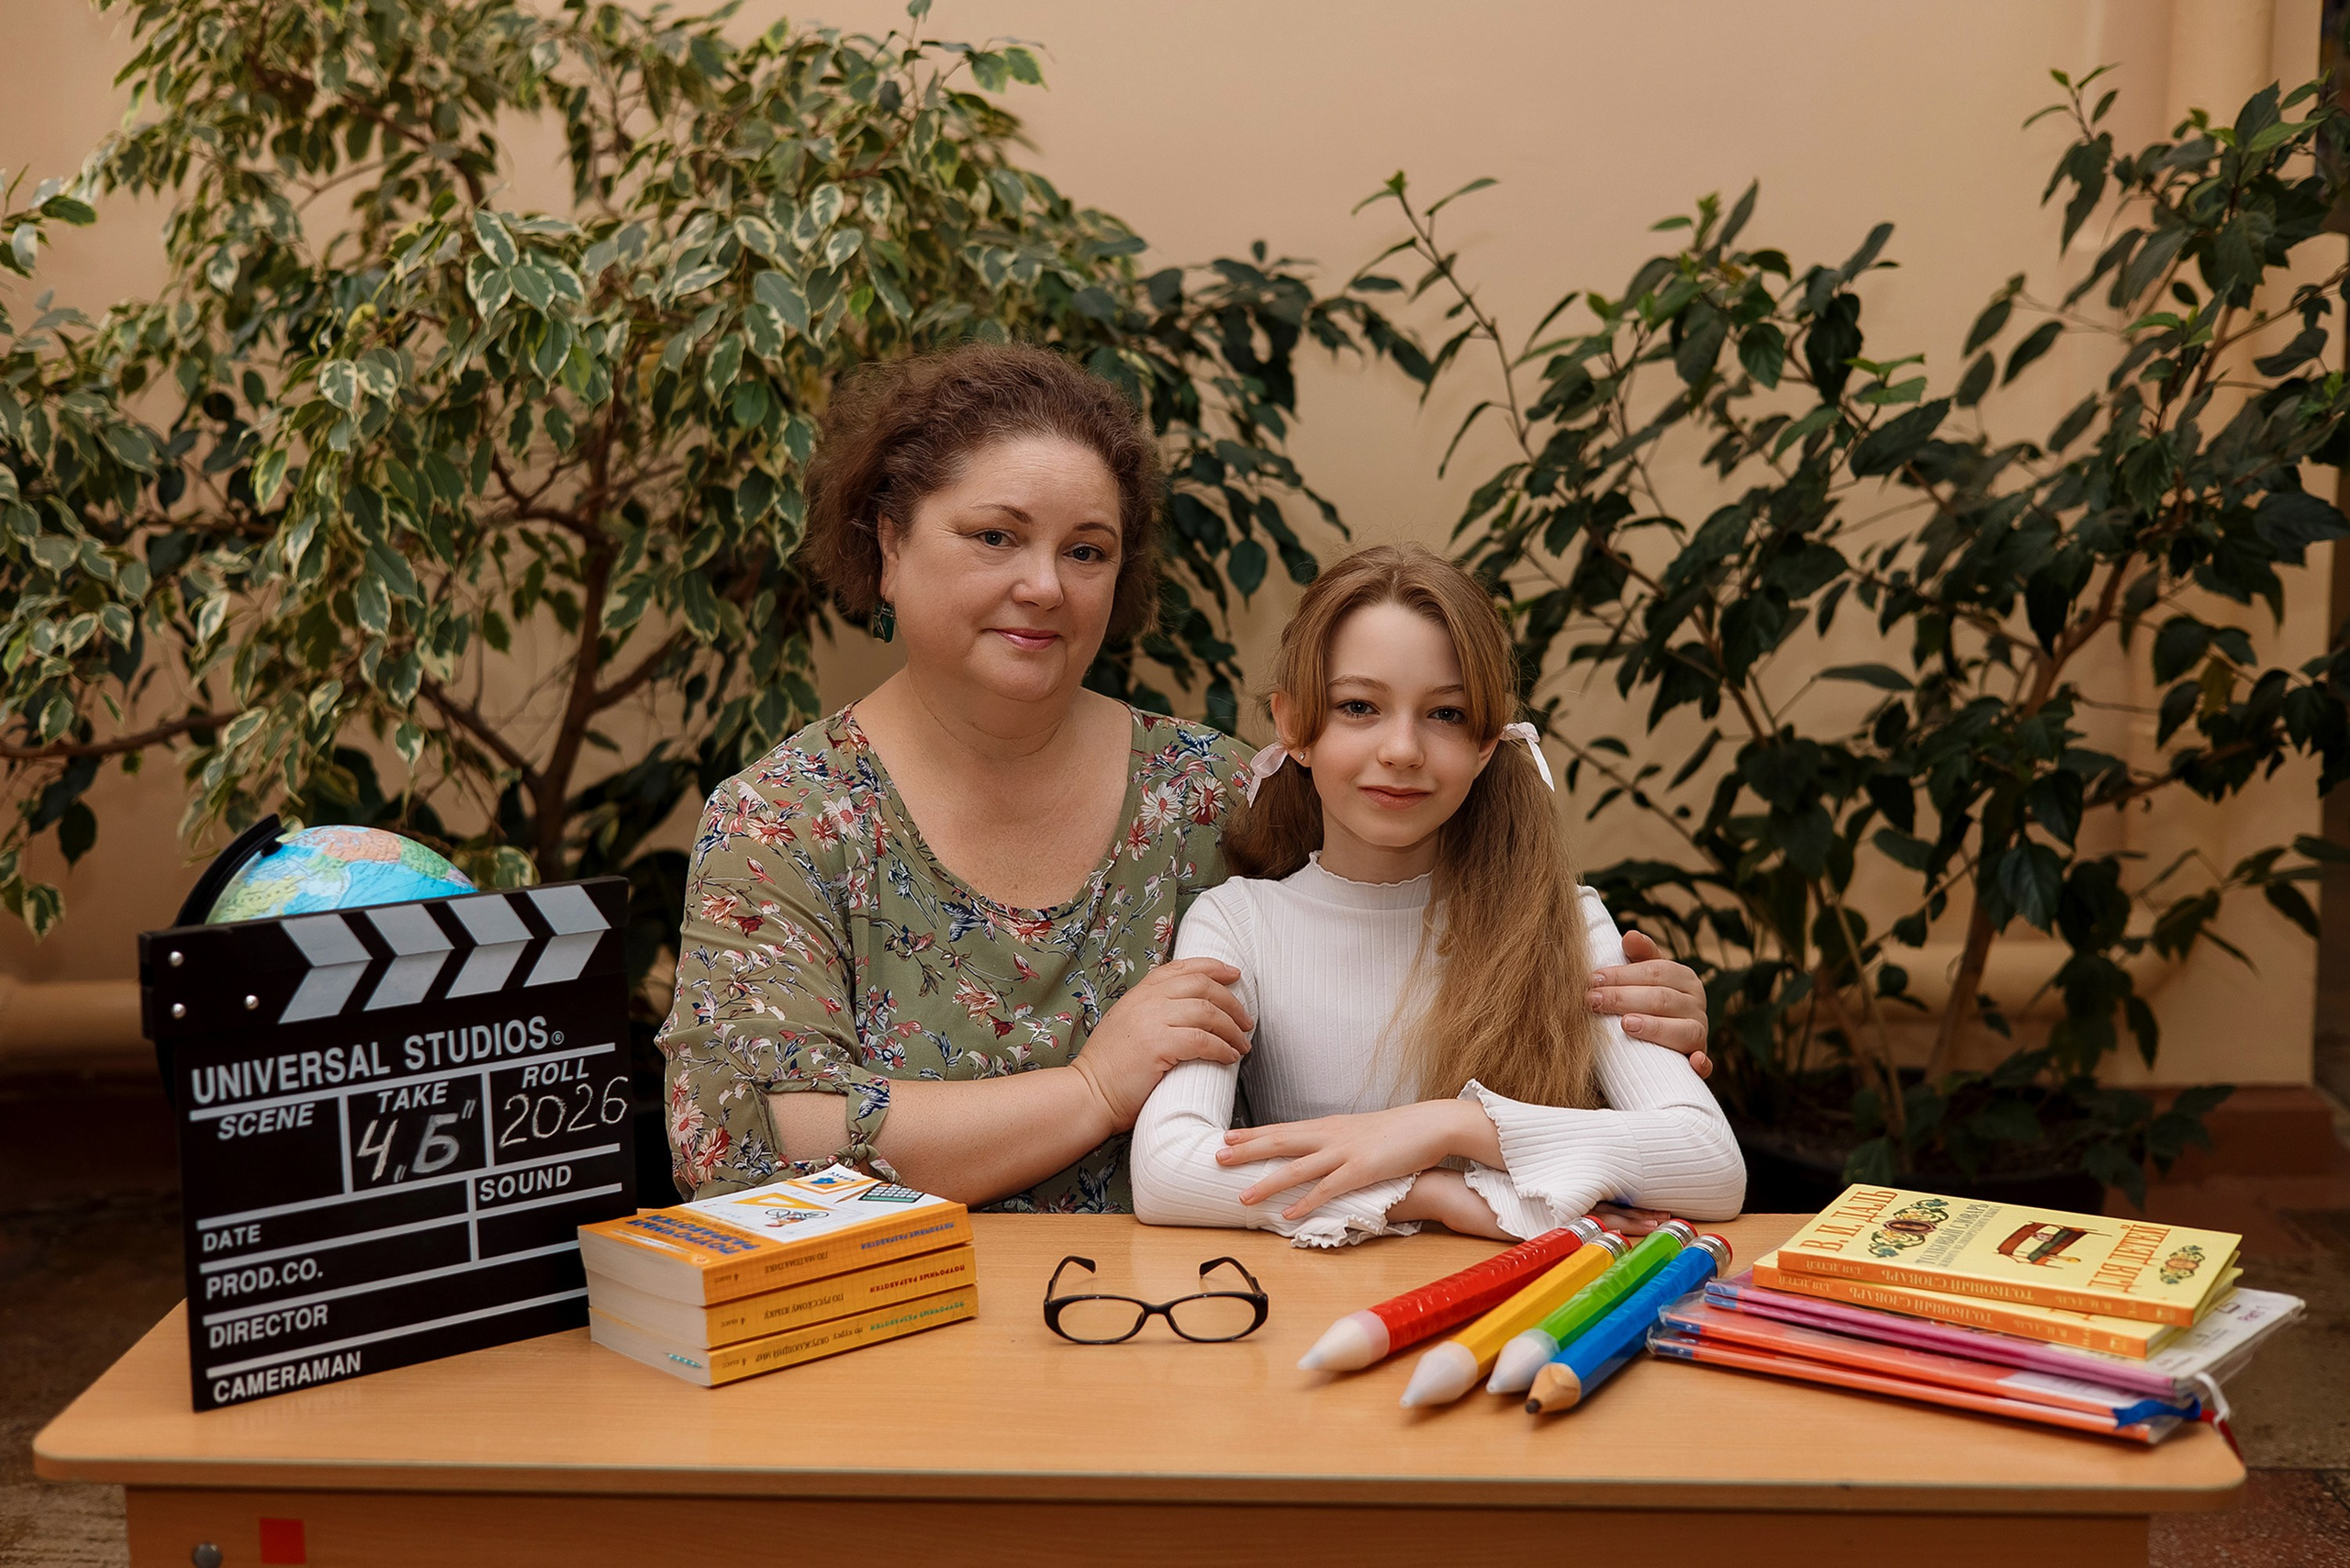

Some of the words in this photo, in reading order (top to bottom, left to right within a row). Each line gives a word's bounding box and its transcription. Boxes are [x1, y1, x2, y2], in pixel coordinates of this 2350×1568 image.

[191, 1041, 390, 1104] UNIVERSAL
[521, 1058, 590, 1089] ROLL
[377, 1081, 450, 1114] TAKE
[217, 1103, 316, 1141] SCENE
[499, 1076, 629, 1148] 2026
[479, 1165, 573, 1202] SOUND
[1830, 1190, 1898, 1225] ДАЛЬ
[203, 1225, 263, 1253] DATE
[626, 1218, 741, 1255] ПОУРОЧНЫЕ
[645, 1215, 761, 1250] РАЗРАБОТКИ
[910, 1222, 955, 1238] ПОУРОЧНЫЕ
[1814, 1223, 1864, 1238] И.
[1915, 1227, 1961, 1264] ТОЛКОВЫЙ
[1953, 1204, 1990, 1231] СЛОВАРЬ
[860, 1234, 908, 1250] РАЗРАБОТКИ
[1798, 1238, 1849, 1252] В.
[2108, 1224, 2171, 1268] ДЕТЕЙ
[765, 1256, 816, 1274] МАТЕМАТИКЕ
[817, 1251, 828, 1260] ПО
[919, 1264, 966, 1282] ПОУРОЧНЫЕ
[1806, 1260, 1838, 1272] ДЕТЕЙ
[1842, 1265, 1865, 1275] ДЛЯ
[207, 1258, 324, 1299] PROD.CO.
[870, 1276, 918, 1294] РАЗРАБОТКИ
[1779, 1275, 1810, 1287] ДЕТЕЙ
[1812, 1280, 1834, 1291] ДЛЯ
[1882, 1271, 1947, 1290] СЛОВАРЬ
[2087, 1262, 2142, 1294] ДЛЯ
[832, 1293, 845, 1302] ПО
[1849, 1286, 1911, 1307] СЛОВАРЬ
[1951, 1278, 2034, 1302] ТОЛКОВЫЙ
[764, 1305, 790, 1319] ЯЗЫКУ
[791, 1296, 832, 1314] РУССКОМУ
[919, 1302, 965, 1318] ПОУРОЧНЫЕ
[1914, 1300, 1993, 1324] ТОЛКОВЫЙ
[209, 1305, 329, 1350] DIRECTOR
[870, 1315, 918, 1331] РАЗРАБОТКИ
[834, 1329, 853, 1339] курсу
[755, 1352, 771, 1362] МИР
[772, 1337, 830, 1359] ОКРУЖАЮЩИЙ
[213, 1352, 363, 1404] CAMERAMAN
